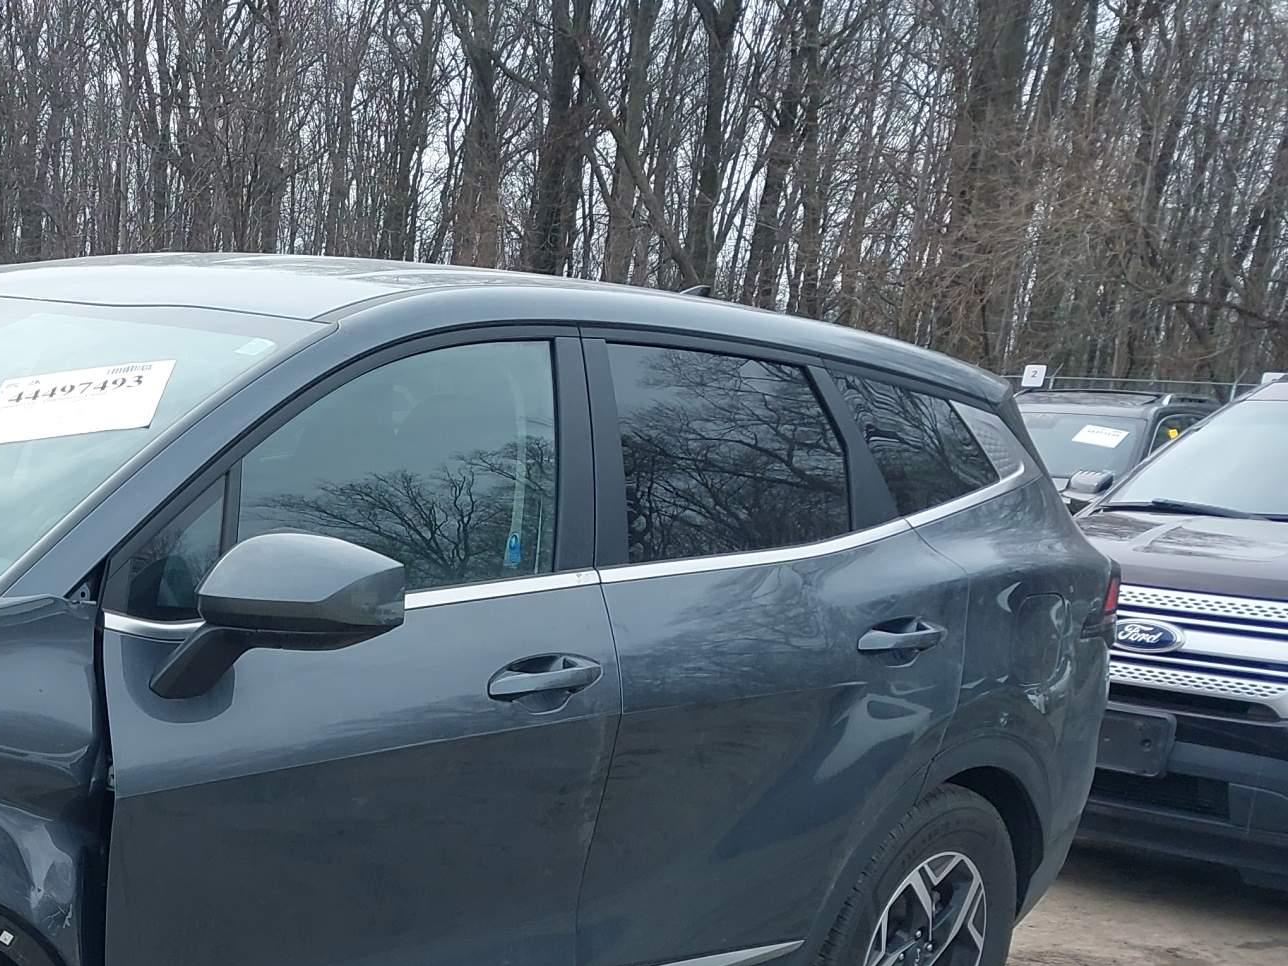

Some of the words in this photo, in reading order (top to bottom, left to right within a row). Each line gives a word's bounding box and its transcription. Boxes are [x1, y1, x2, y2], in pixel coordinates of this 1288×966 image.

[1031, 370, 1038, 378] 2
[7, 375, 143, 403] 44497493
[1118, 623, 1163, 644] Ford
